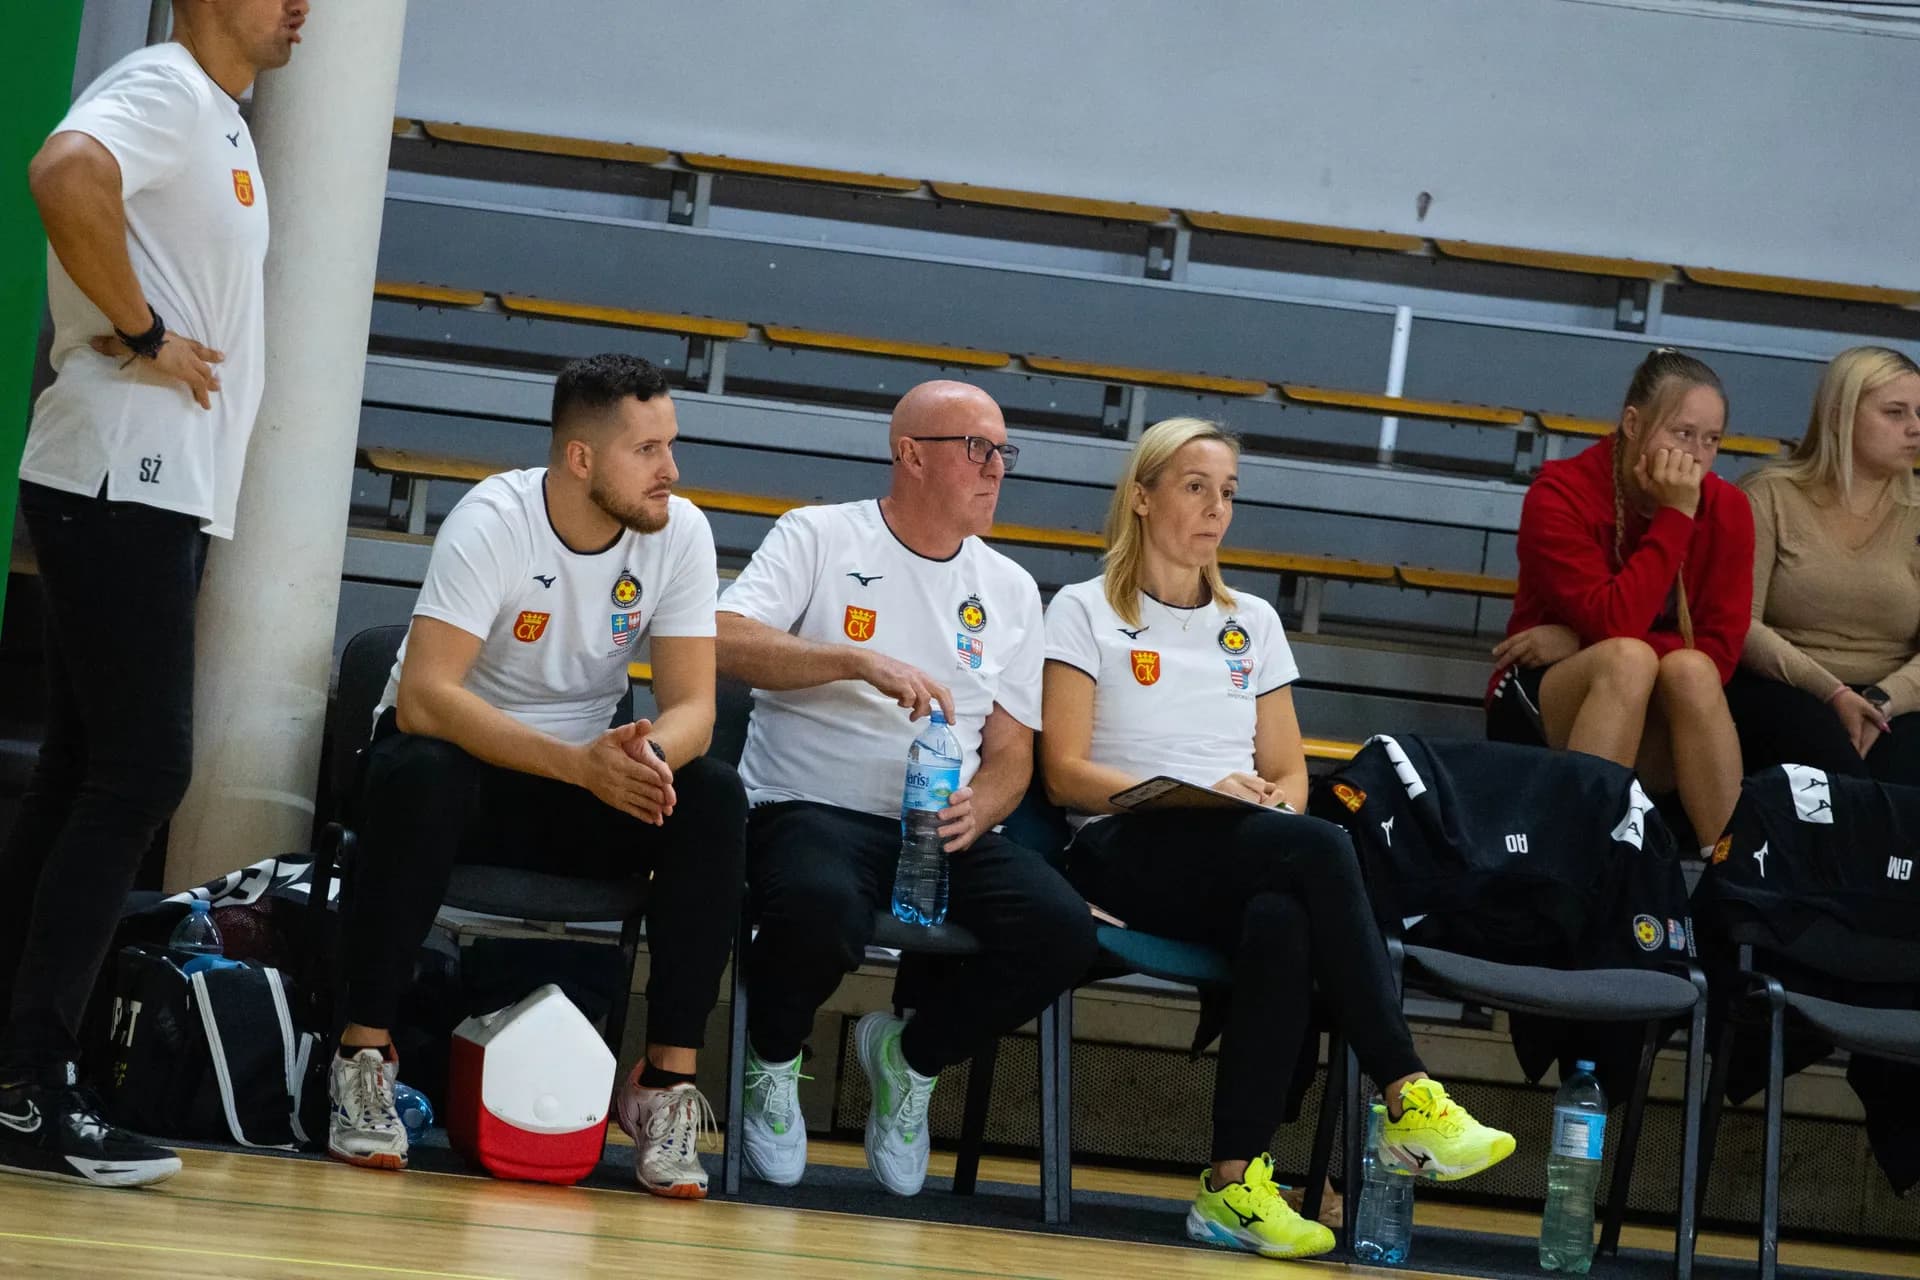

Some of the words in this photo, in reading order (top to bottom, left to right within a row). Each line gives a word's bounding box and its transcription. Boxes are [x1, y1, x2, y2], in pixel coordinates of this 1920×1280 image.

[140, 454, 162, 484] SŻ
[517, 623, 540, 640] CK
[848, 620, 870, 639] CK
[1136, 664, 1156, 681] CK
[1887, 856, 1912, 880] GM
